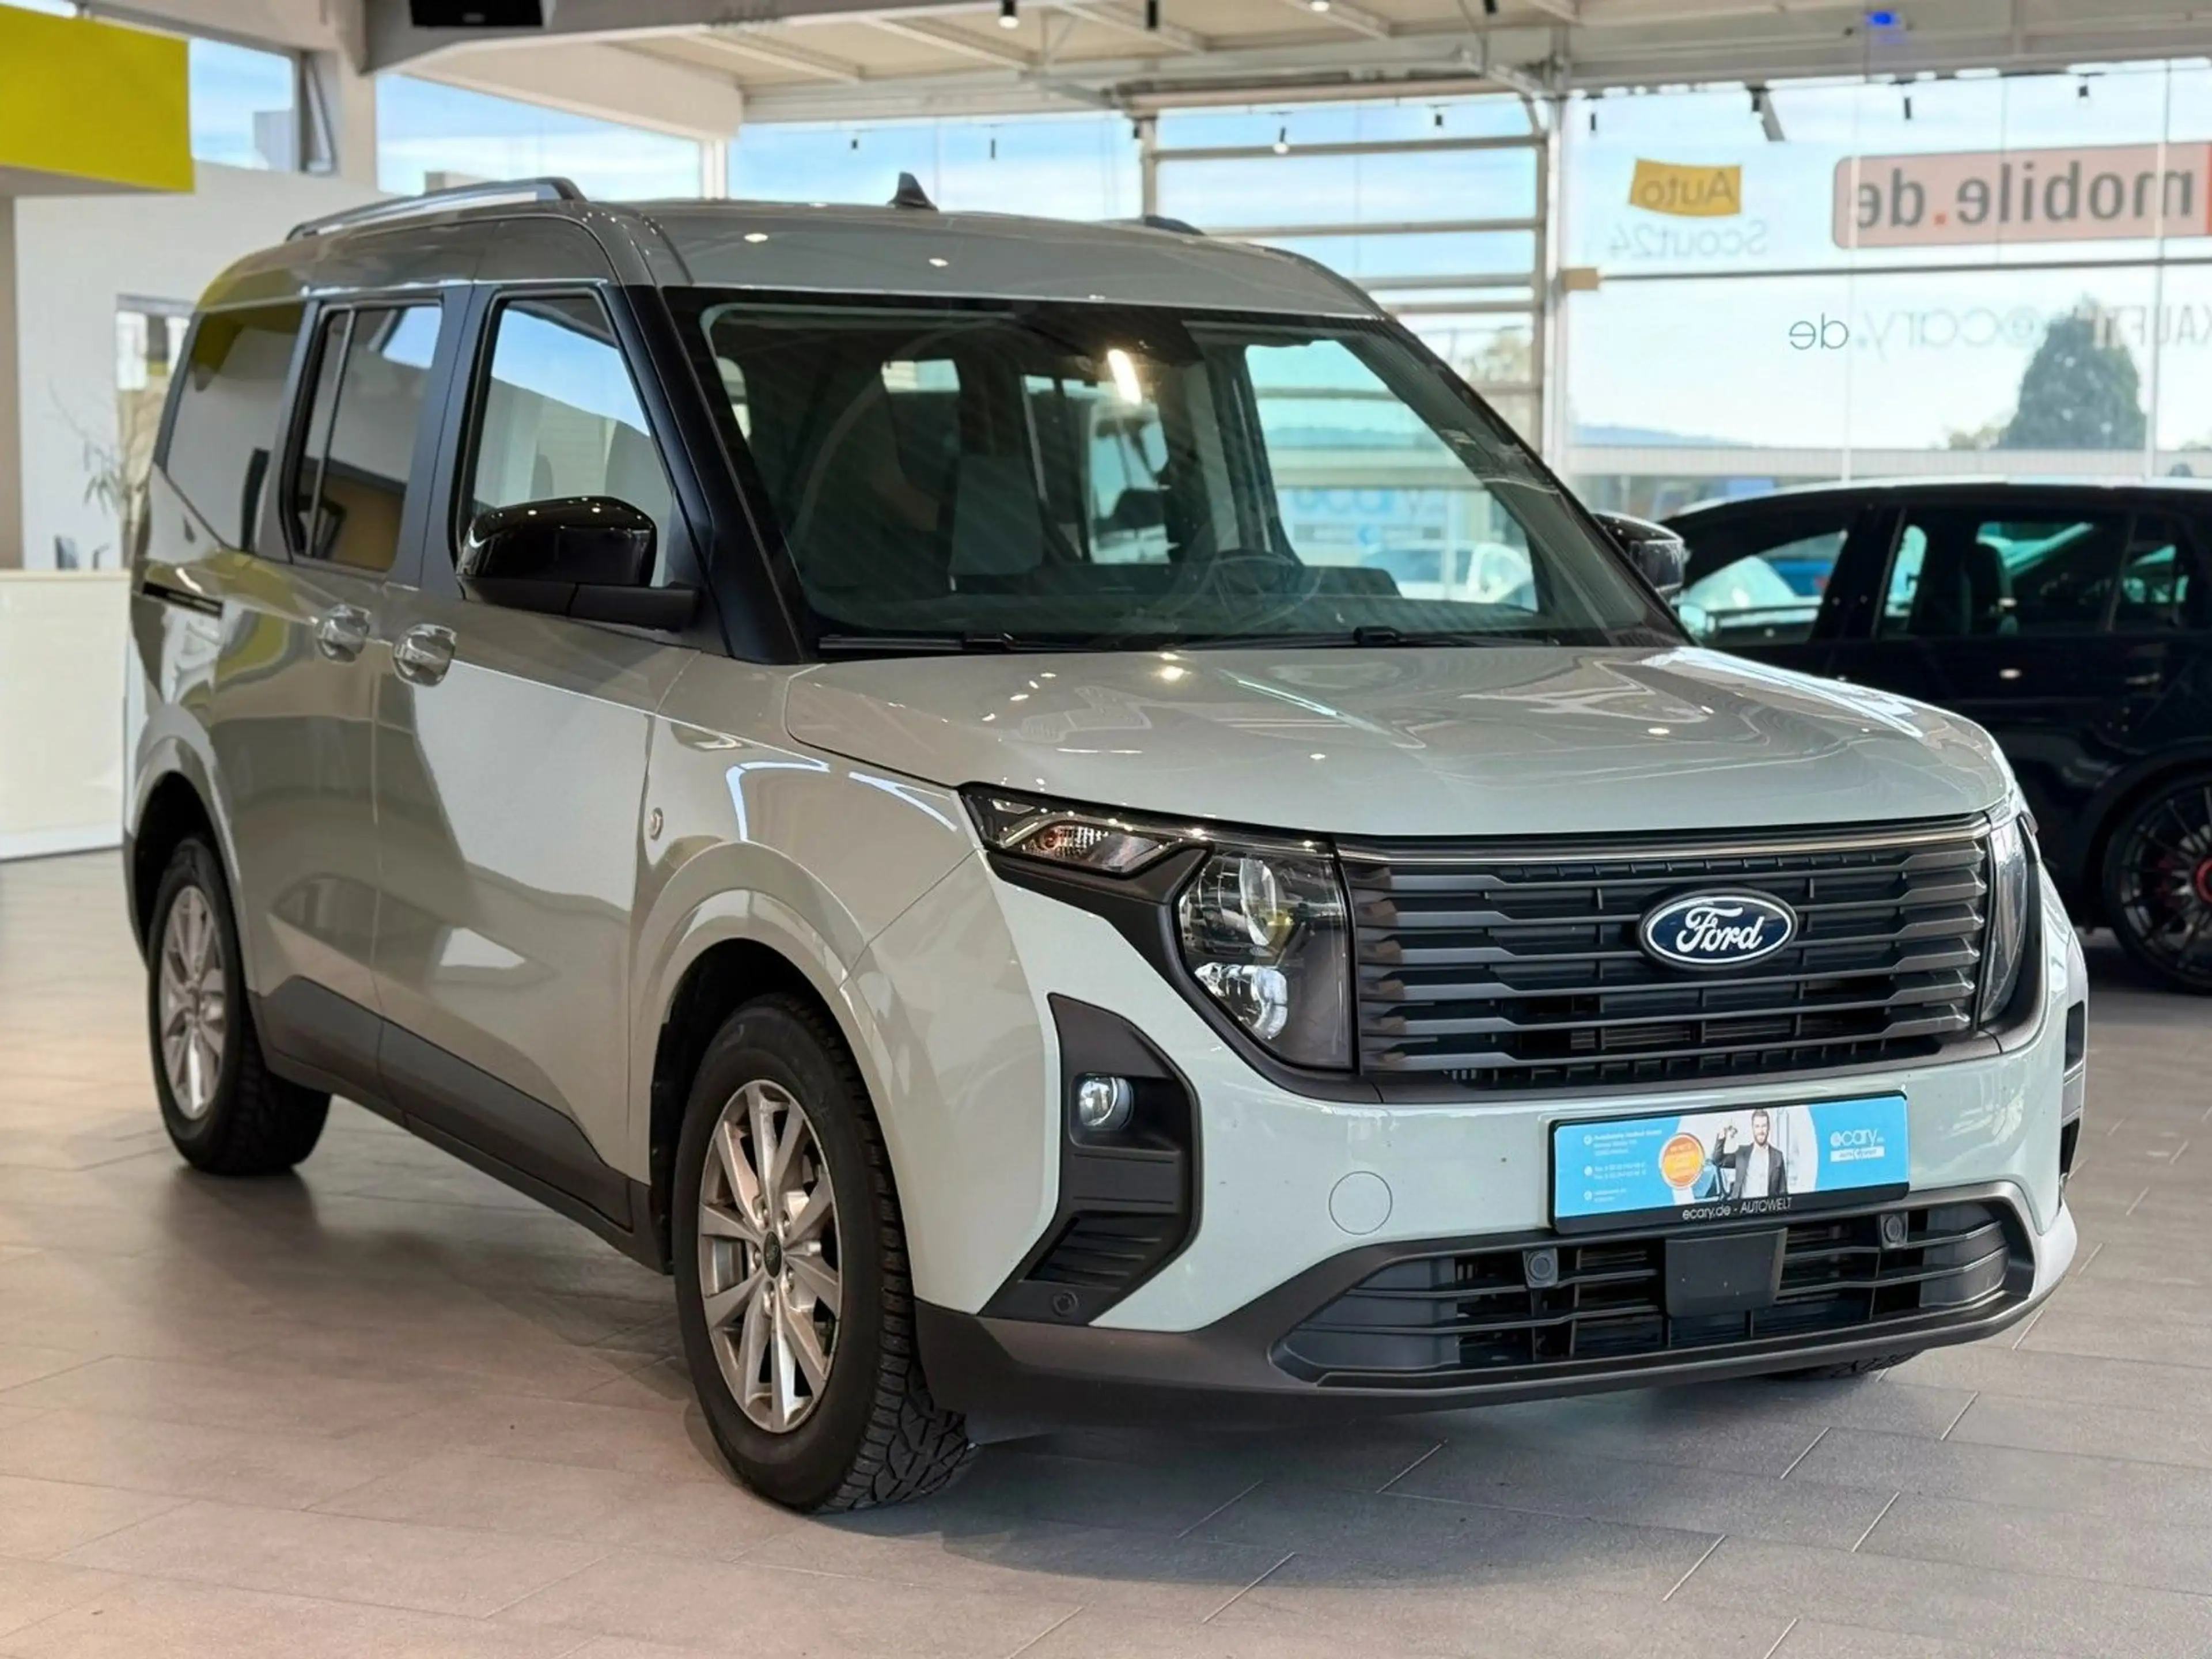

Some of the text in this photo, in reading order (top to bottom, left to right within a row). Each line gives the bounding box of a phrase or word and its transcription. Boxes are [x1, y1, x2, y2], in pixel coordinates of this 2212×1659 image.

[1676, 907, 1764, 952] Ford
[1683, 1205, 1730, 1220] ecary.de
[1740, 1197, 1792, 1214] AUTOWELT
